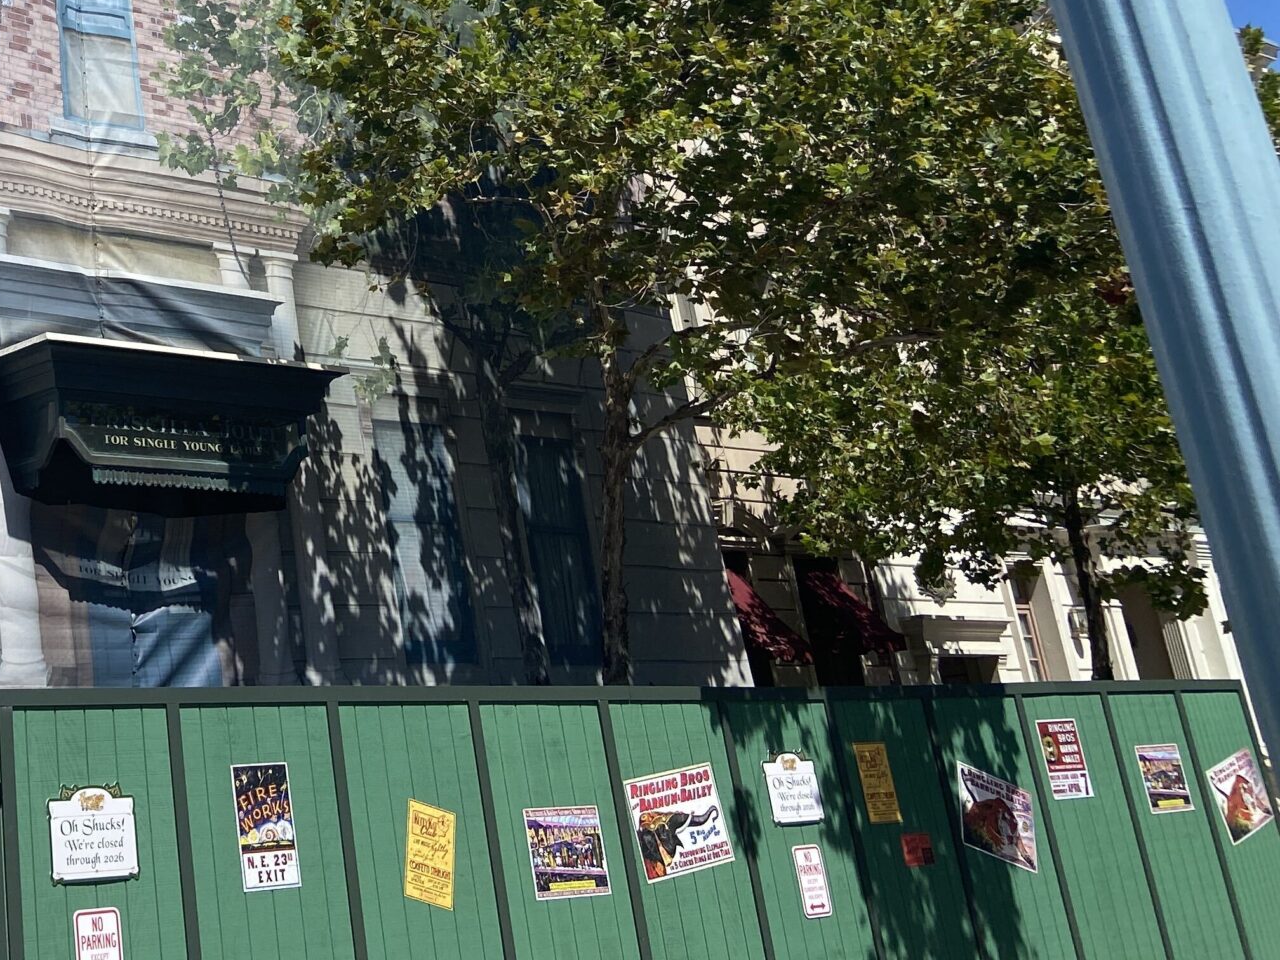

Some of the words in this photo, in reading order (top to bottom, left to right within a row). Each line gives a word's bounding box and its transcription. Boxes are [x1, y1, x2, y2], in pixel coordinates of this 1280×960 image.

[133, 436, 177, 449] SINGLE
[183, 441, 221, 453] YOUNG
[1057, 733, 1075, 743] BROS
[630, 777, 678, 799] RINGLING
[680, 769, 710, 787] BROS
[772, 776, 785, 790] Oh
[1080, 773, 1090, 796] 7
[238, 784, 277, 811] FIRE
[241, 800, 290, 833] WORKS
[60, 819, 78, 836] Oh
[81, 817, 125, 836] Shucks!
[64, 839, 95, 852] We're
[97, 836, 124, 849] closed
[689, 830, 698, 845] 5
[66, 852, 101, 869] through
[103, 851, 125, 864] 2026
[247, 856, 258, 870] N.
[260, 855, 270, 868] E.
[803, 851, 812, 863] NO
[258, 869, 286, 884] EXIT
[798, 863, 822, 876] PARKING
[91, 916, 104, 932] NO
[80, 932, 117, 951] PARKING
